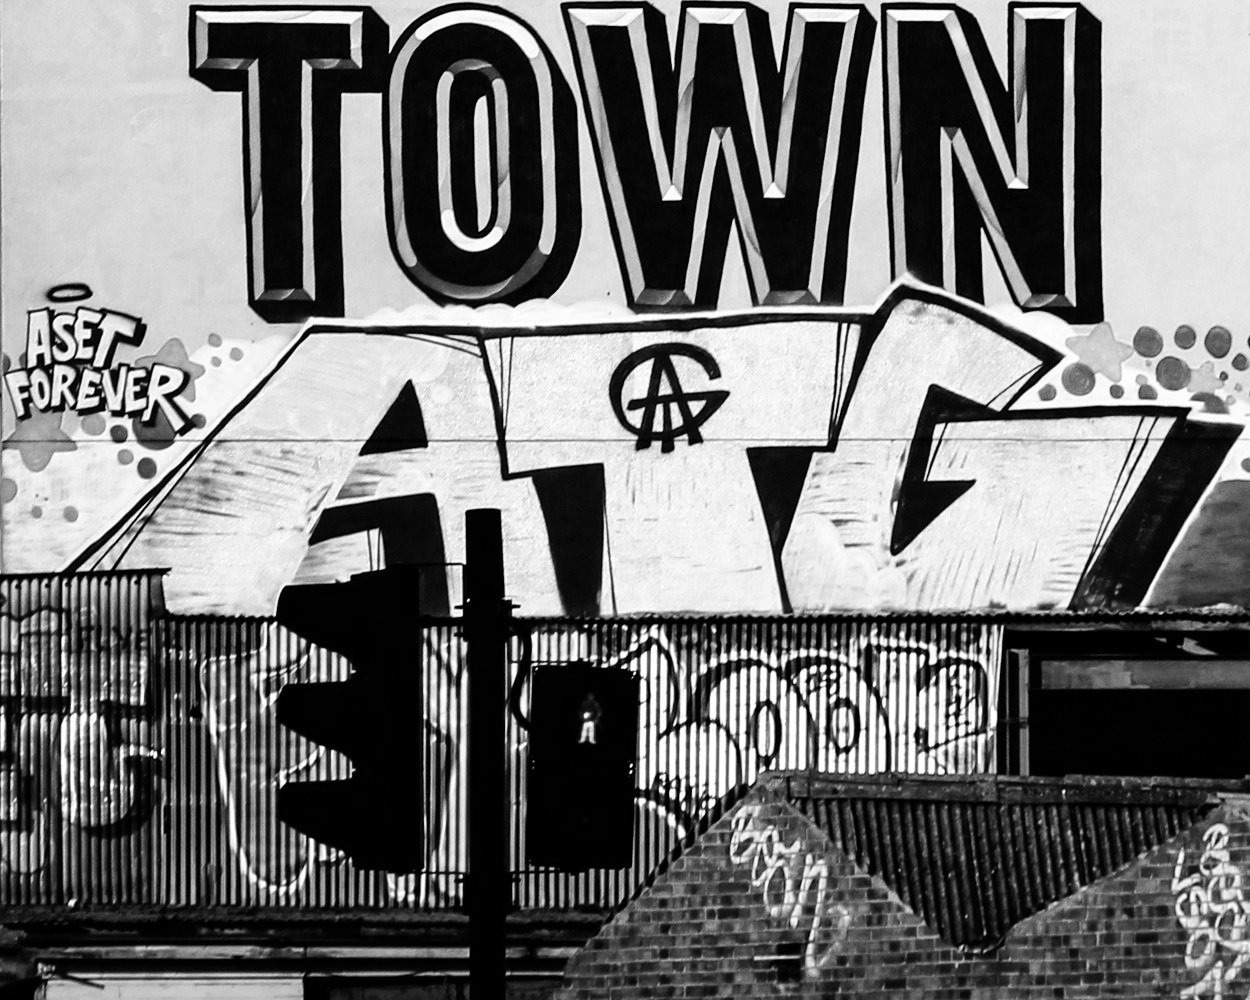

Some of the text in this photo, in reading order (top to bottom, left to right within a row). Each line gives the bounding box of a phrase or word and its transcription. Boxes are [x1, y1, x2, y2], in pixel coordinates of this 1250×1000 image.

[188, 1, 1105, 323] TOWN
[26, 306, 147, 370] ASET
[3, 362, 196, 437] FOREVER
